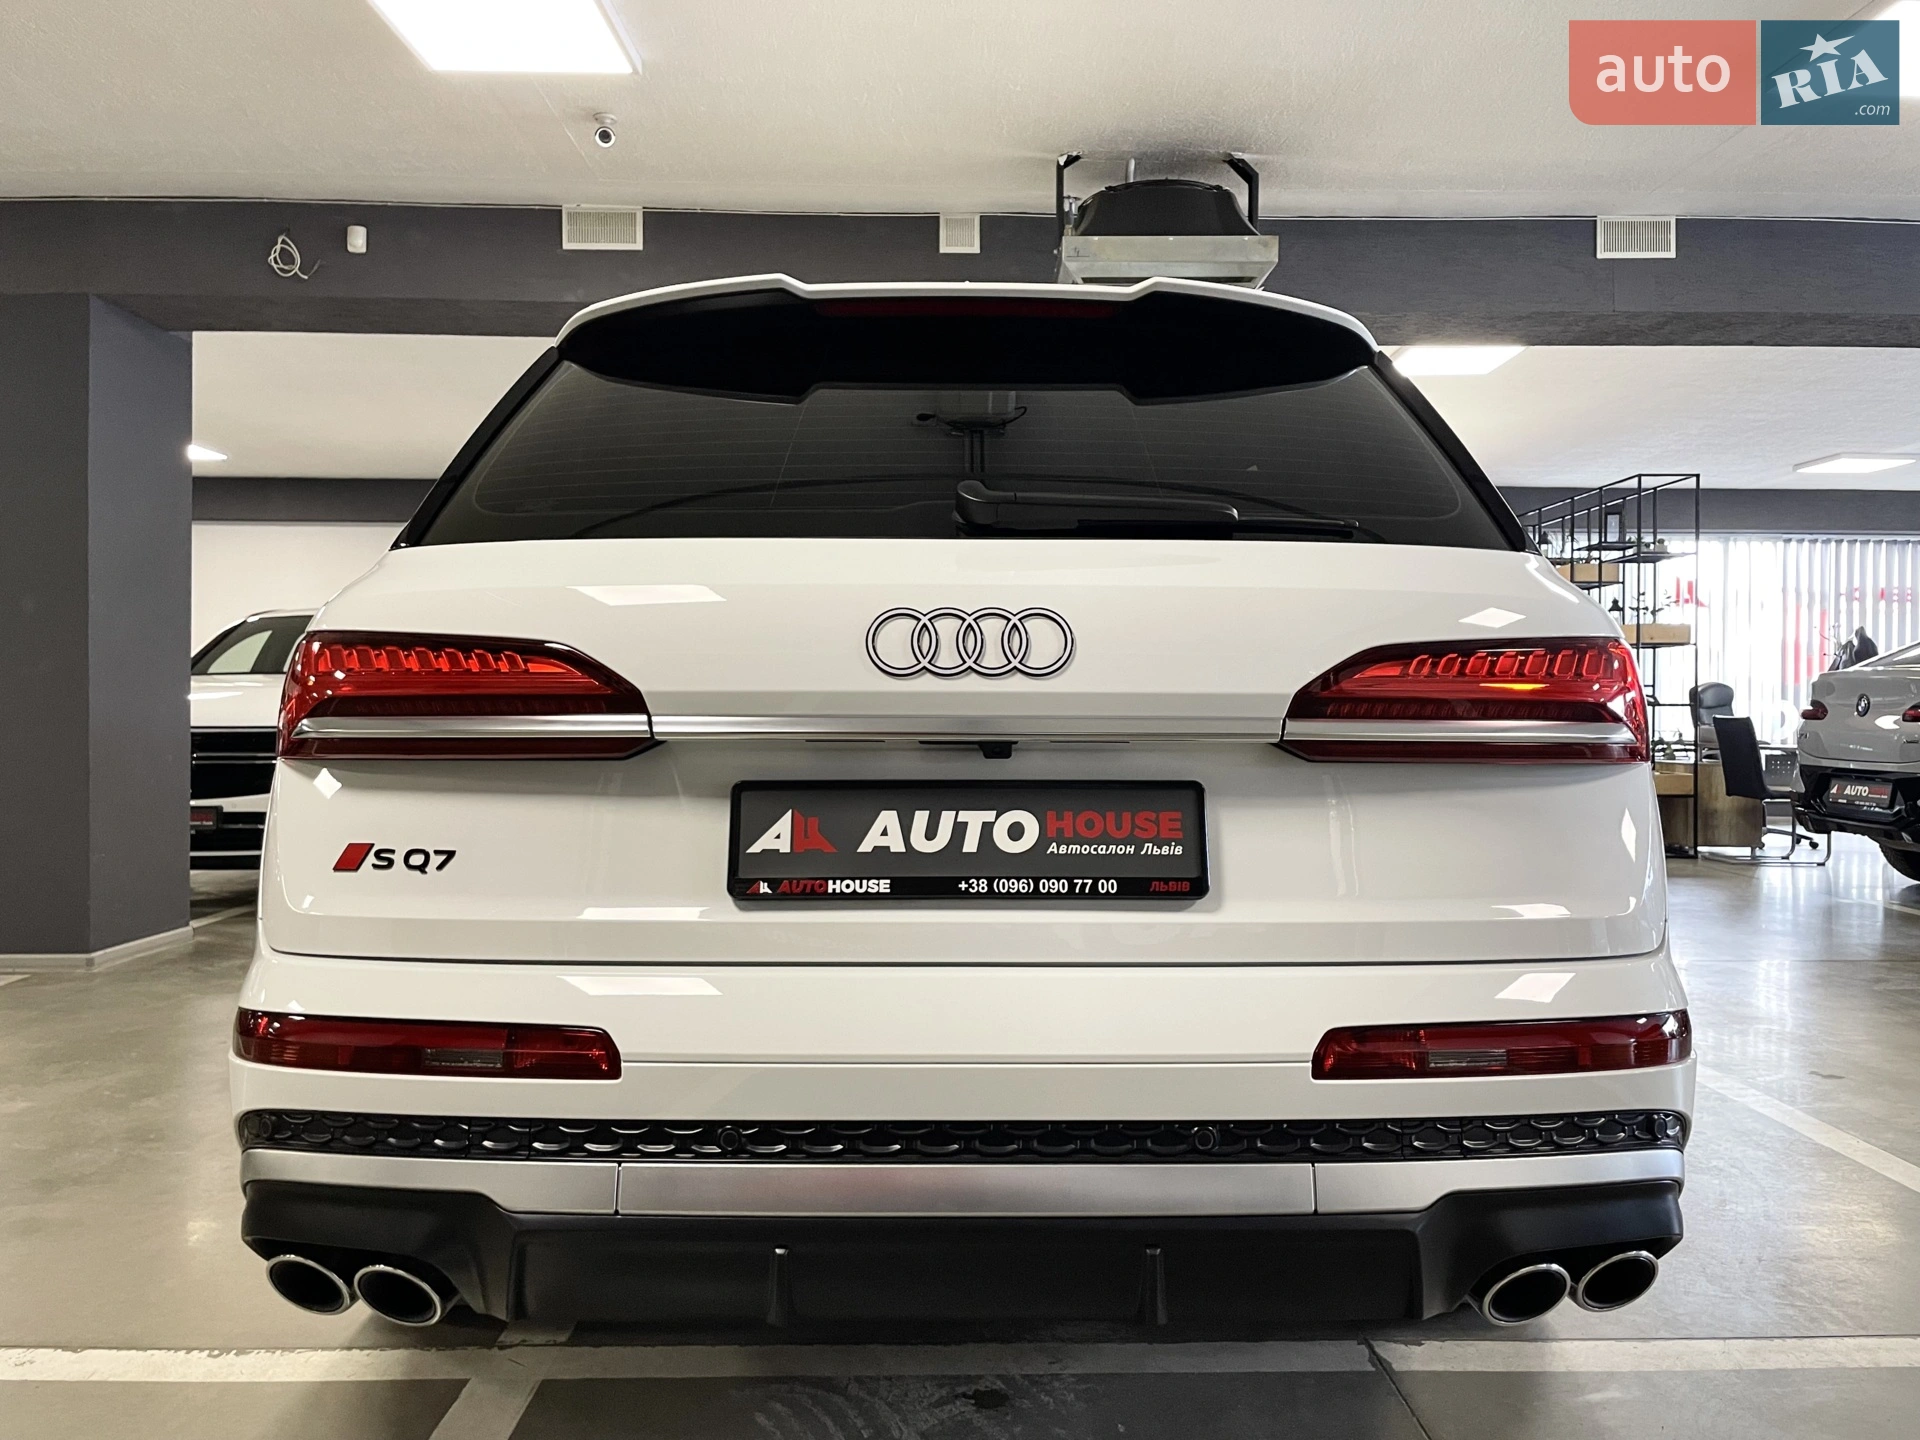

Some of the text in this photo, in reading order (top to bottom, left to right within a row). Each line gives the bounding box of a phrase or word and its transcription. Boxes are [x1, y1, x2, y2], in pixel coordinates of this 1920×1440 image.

[1843, 784, 1869, 797] AUTO
[856, 809, 1040, 854] AUTO
[1046, 810, 1184, 839] HOUSE
[1046, 841, 1184, 856] Автосалон Львів
[958, 878, 1118, 894] +38 (096) 090 77 00
